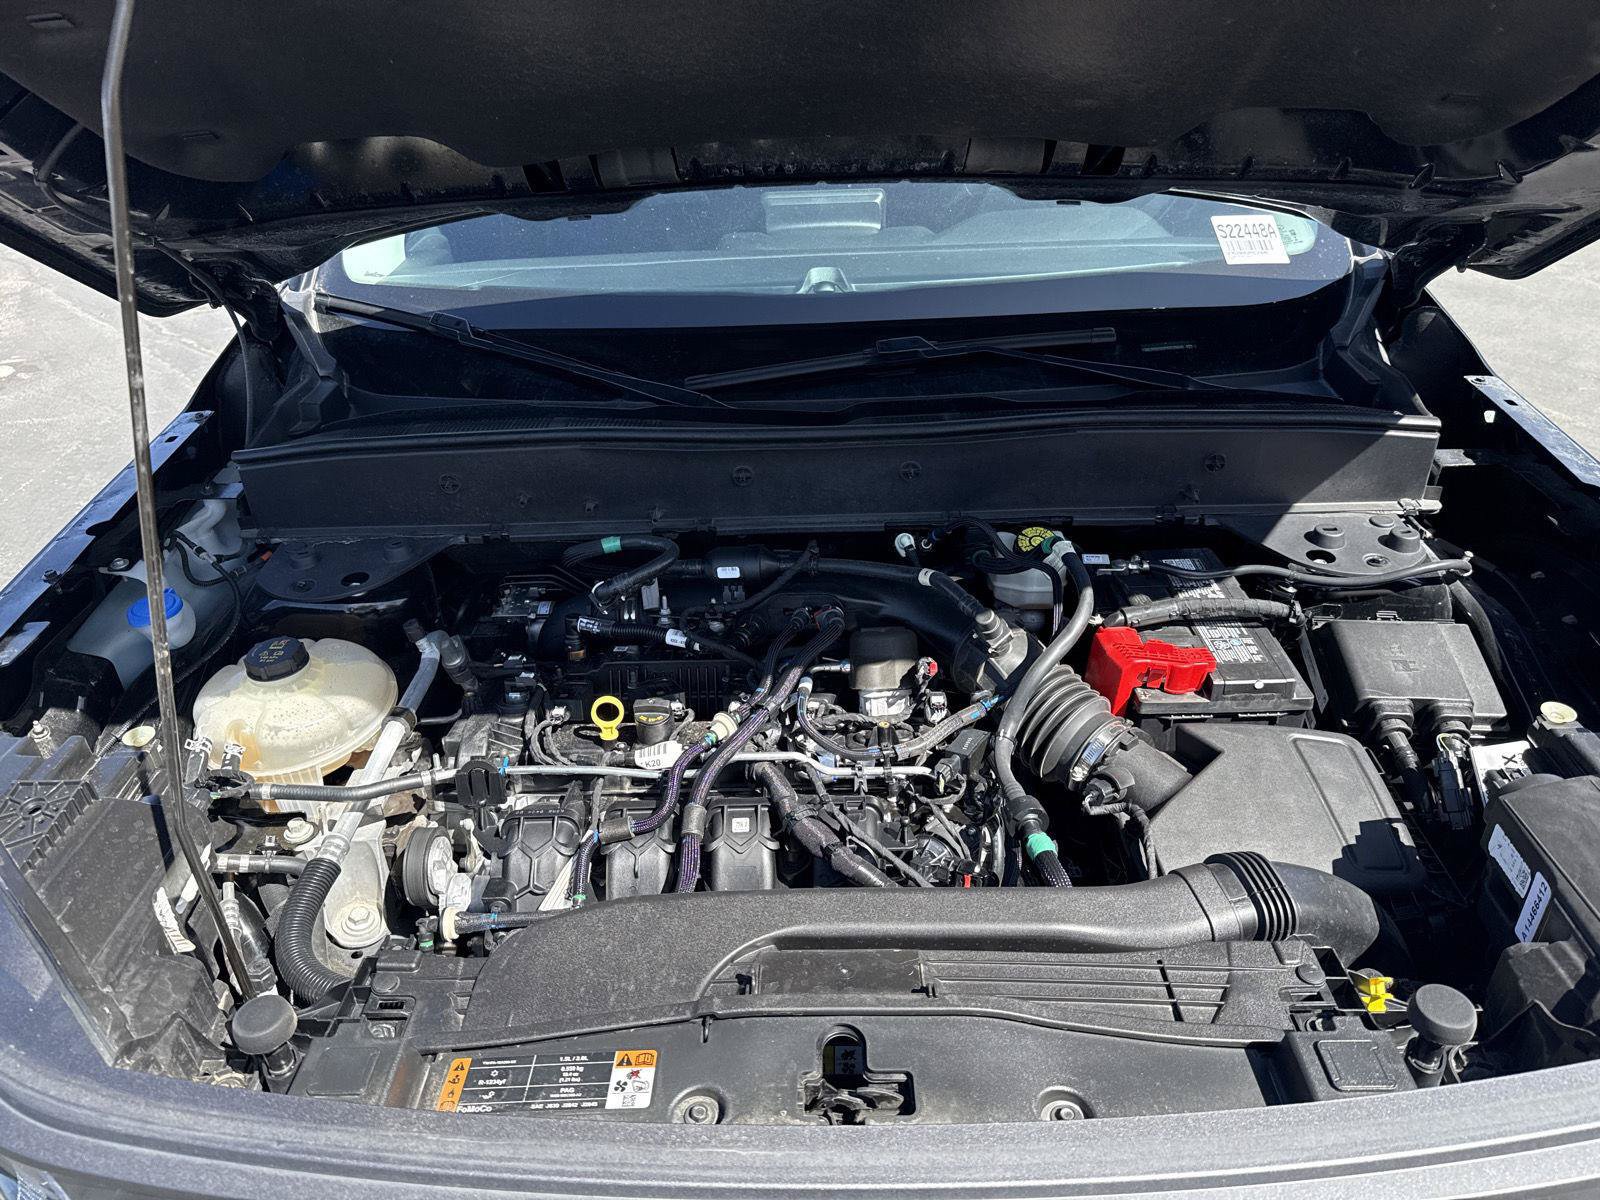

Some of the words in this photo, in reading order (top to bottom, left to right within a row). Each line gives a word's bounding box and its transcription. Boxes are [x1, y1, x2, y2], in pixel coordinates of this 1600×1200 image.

[1217, 224, 1277, 238] S22448A
[1521, 881, 1549, 942] A14466412
[456, 1105, 493, 1113] FoMoCo
